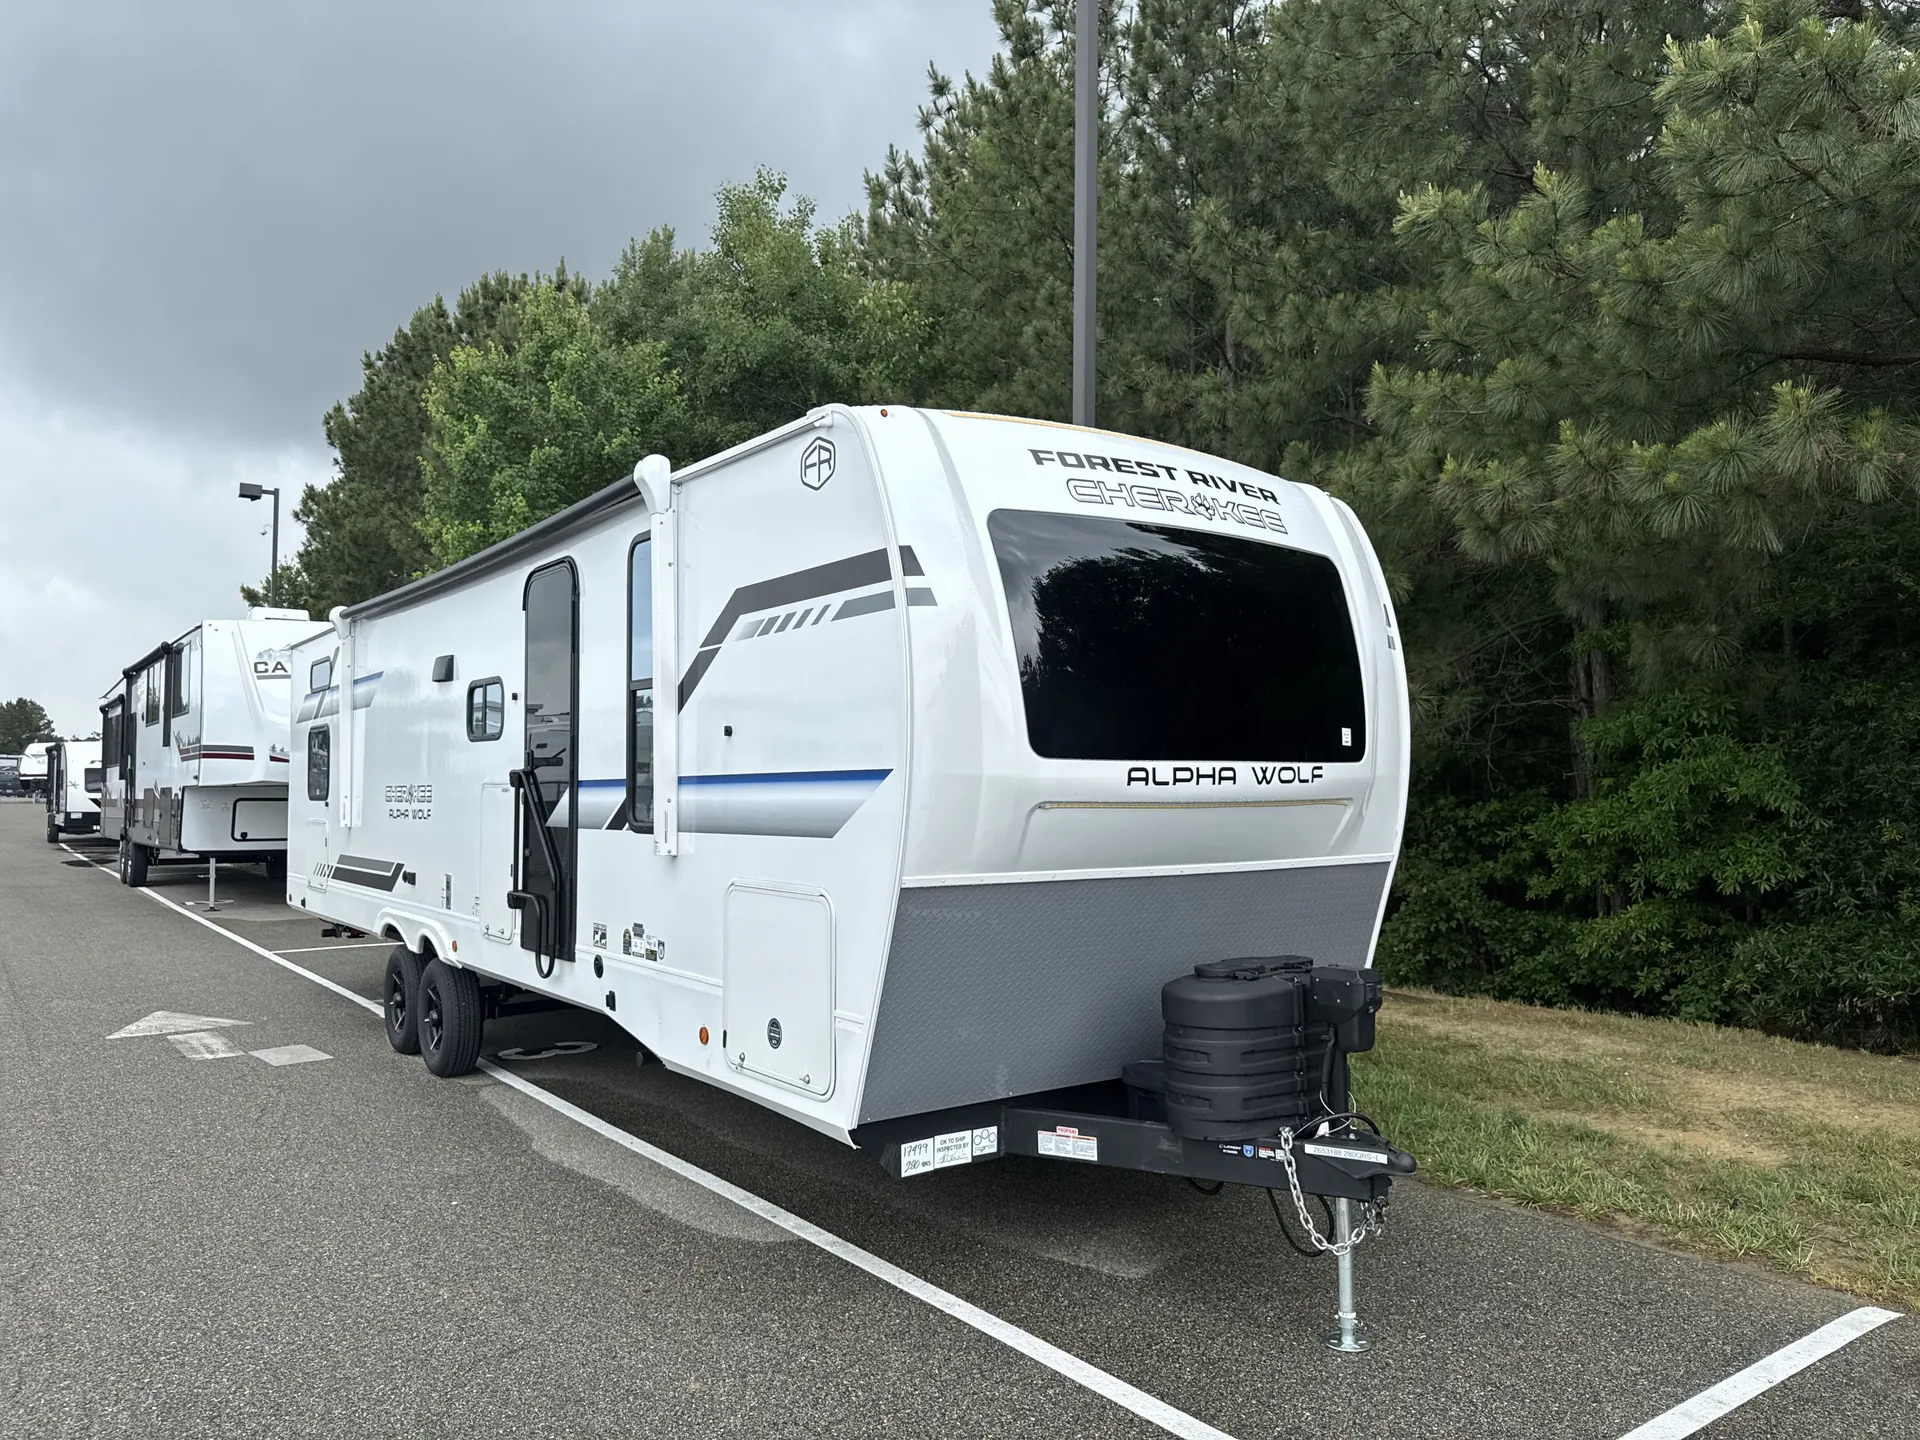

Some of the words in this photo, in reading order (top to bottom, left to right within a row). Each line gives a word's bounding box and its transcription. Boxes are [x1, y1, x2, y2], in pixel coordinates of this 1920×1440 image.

[1028, 448, 1178, 481] FOREST
[1184, 468, 1281, 506] RIVER
[1126, 766, 1237, 786] ALPHA
[1251, 765, 1324, 785] WOLF
[388, 808, 410, 820] ALPHA
[411, 808, 432, 820] WOLF
[937, 1144, 962, 1153] INSPECTED
[1313, 1146, 1342, 1156] 2653188
